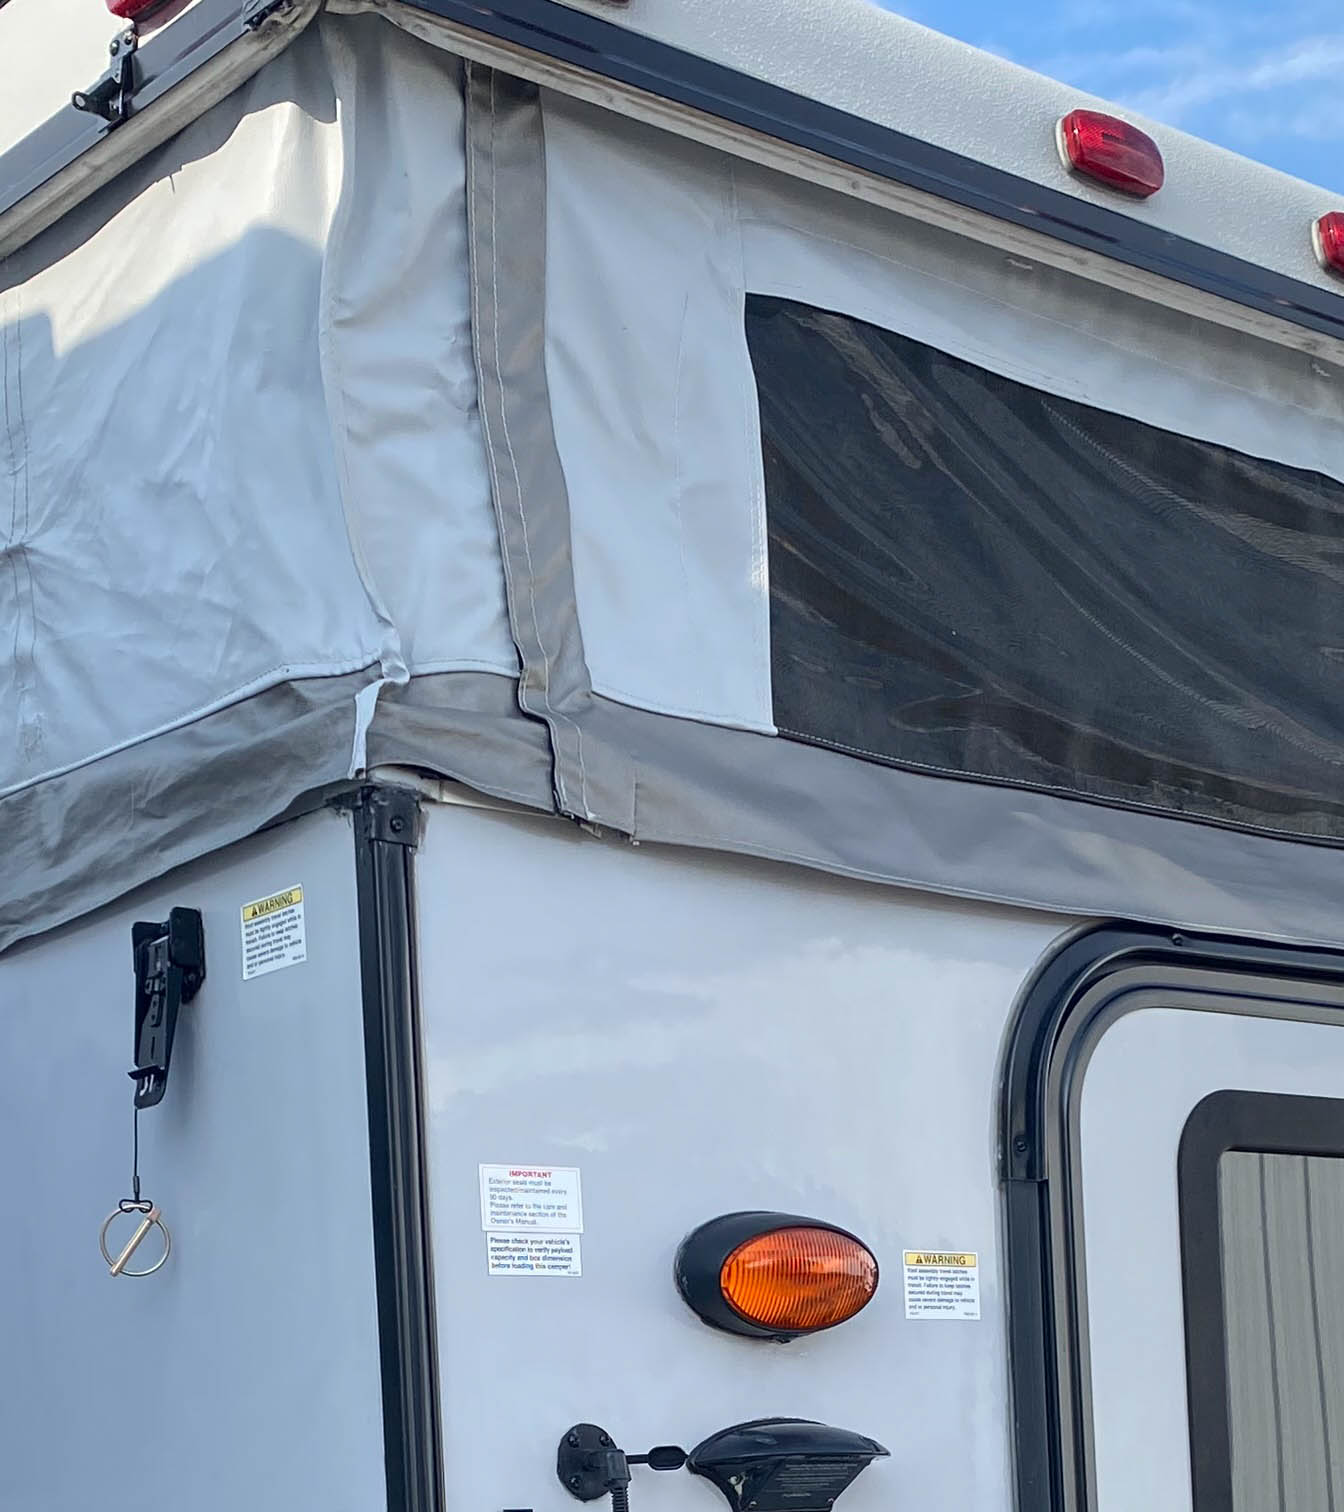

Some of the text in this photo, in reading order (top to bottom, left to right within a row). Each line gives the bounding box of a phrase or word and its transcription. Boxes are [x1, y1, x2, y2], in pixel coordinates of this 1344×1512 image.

[258, 892, 293, 913] WARNING
[509, 1170, 552, 1178] IMPORTANT
[924, 1255, 966, 1265] WARNING
